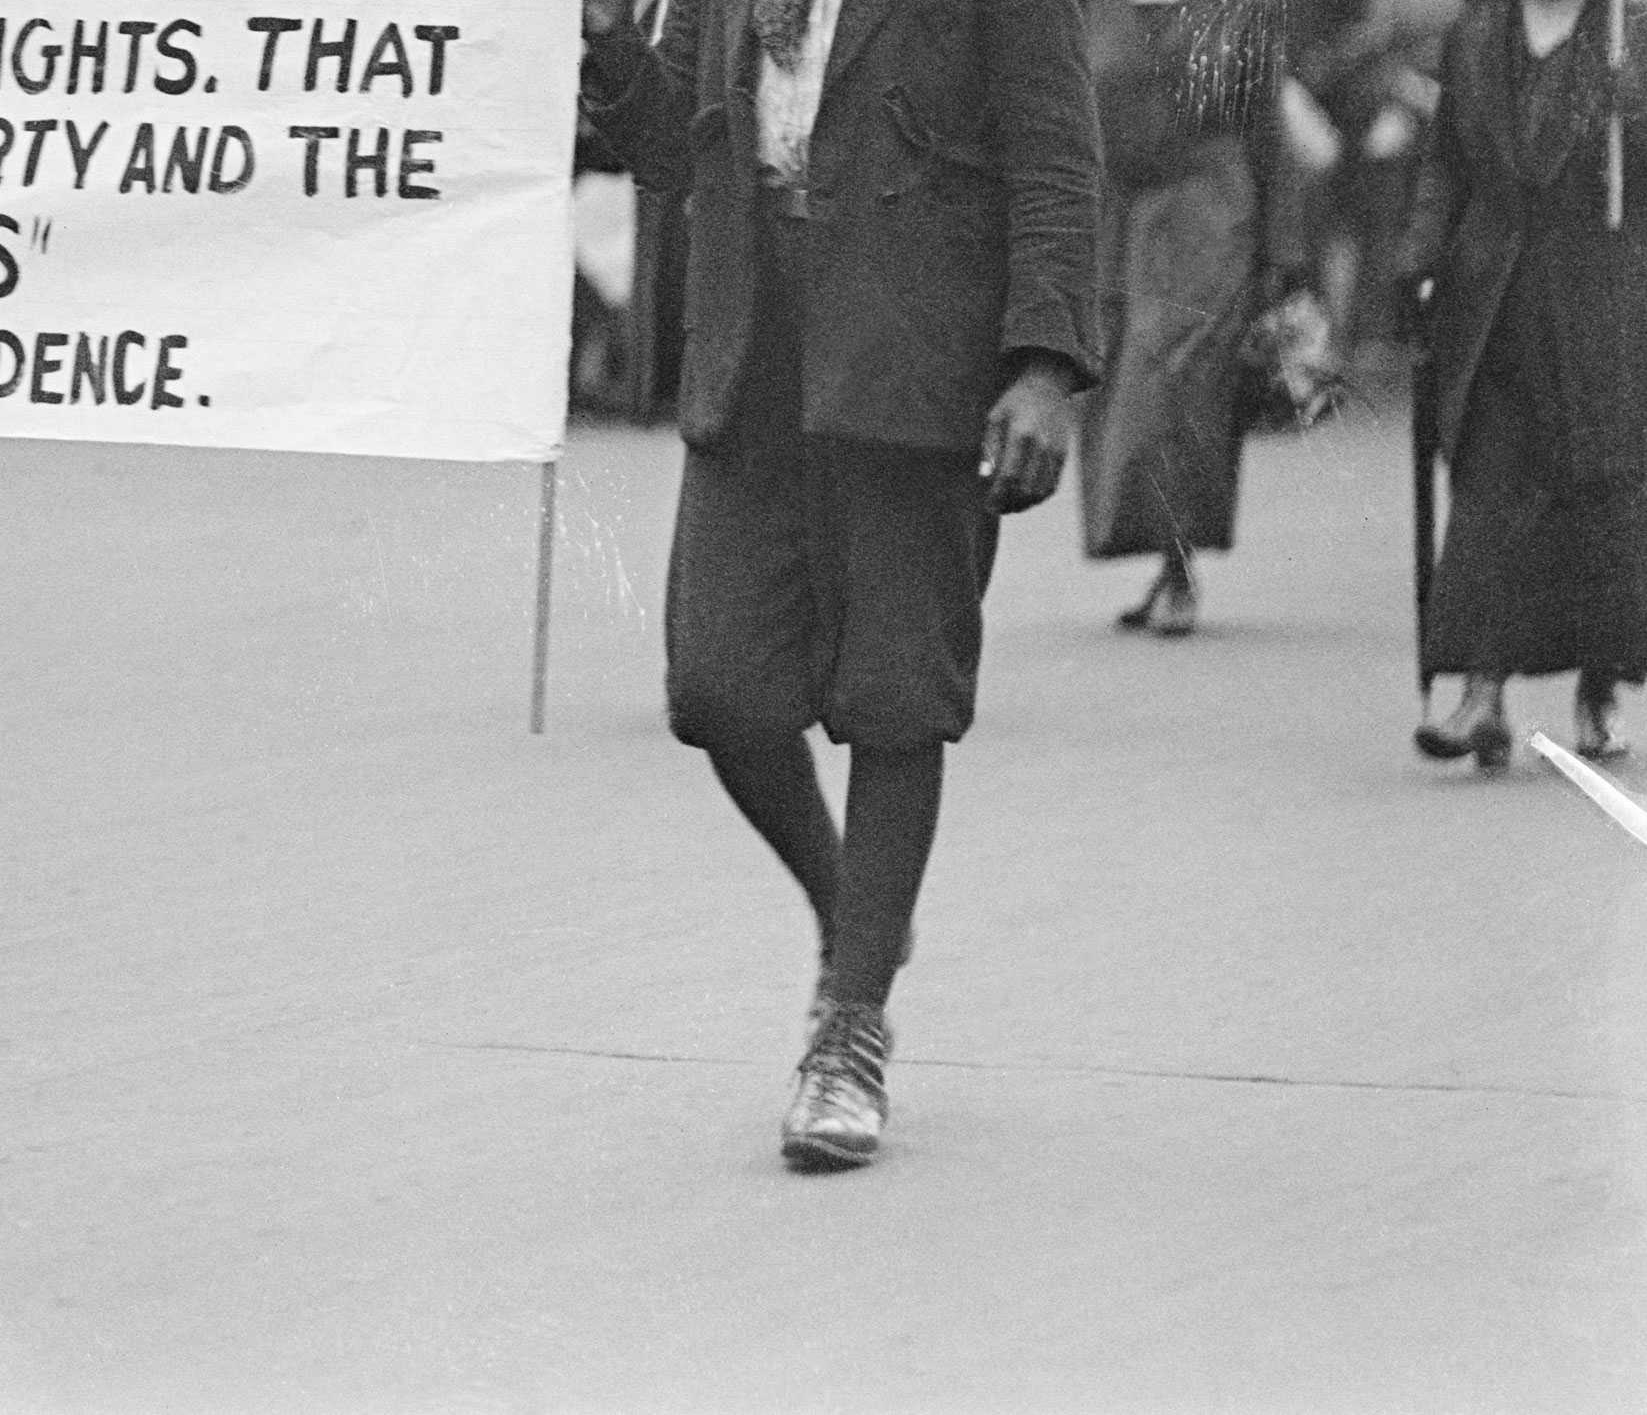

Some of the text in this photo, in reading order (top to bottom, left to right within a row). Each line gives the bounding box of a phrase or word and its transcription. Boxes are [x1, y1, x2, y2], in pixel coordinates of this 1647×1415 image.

[247, 16, 460, 98] THAT
[119, 122, 254, 195] AND
[289, 125, 443, 200] THE
